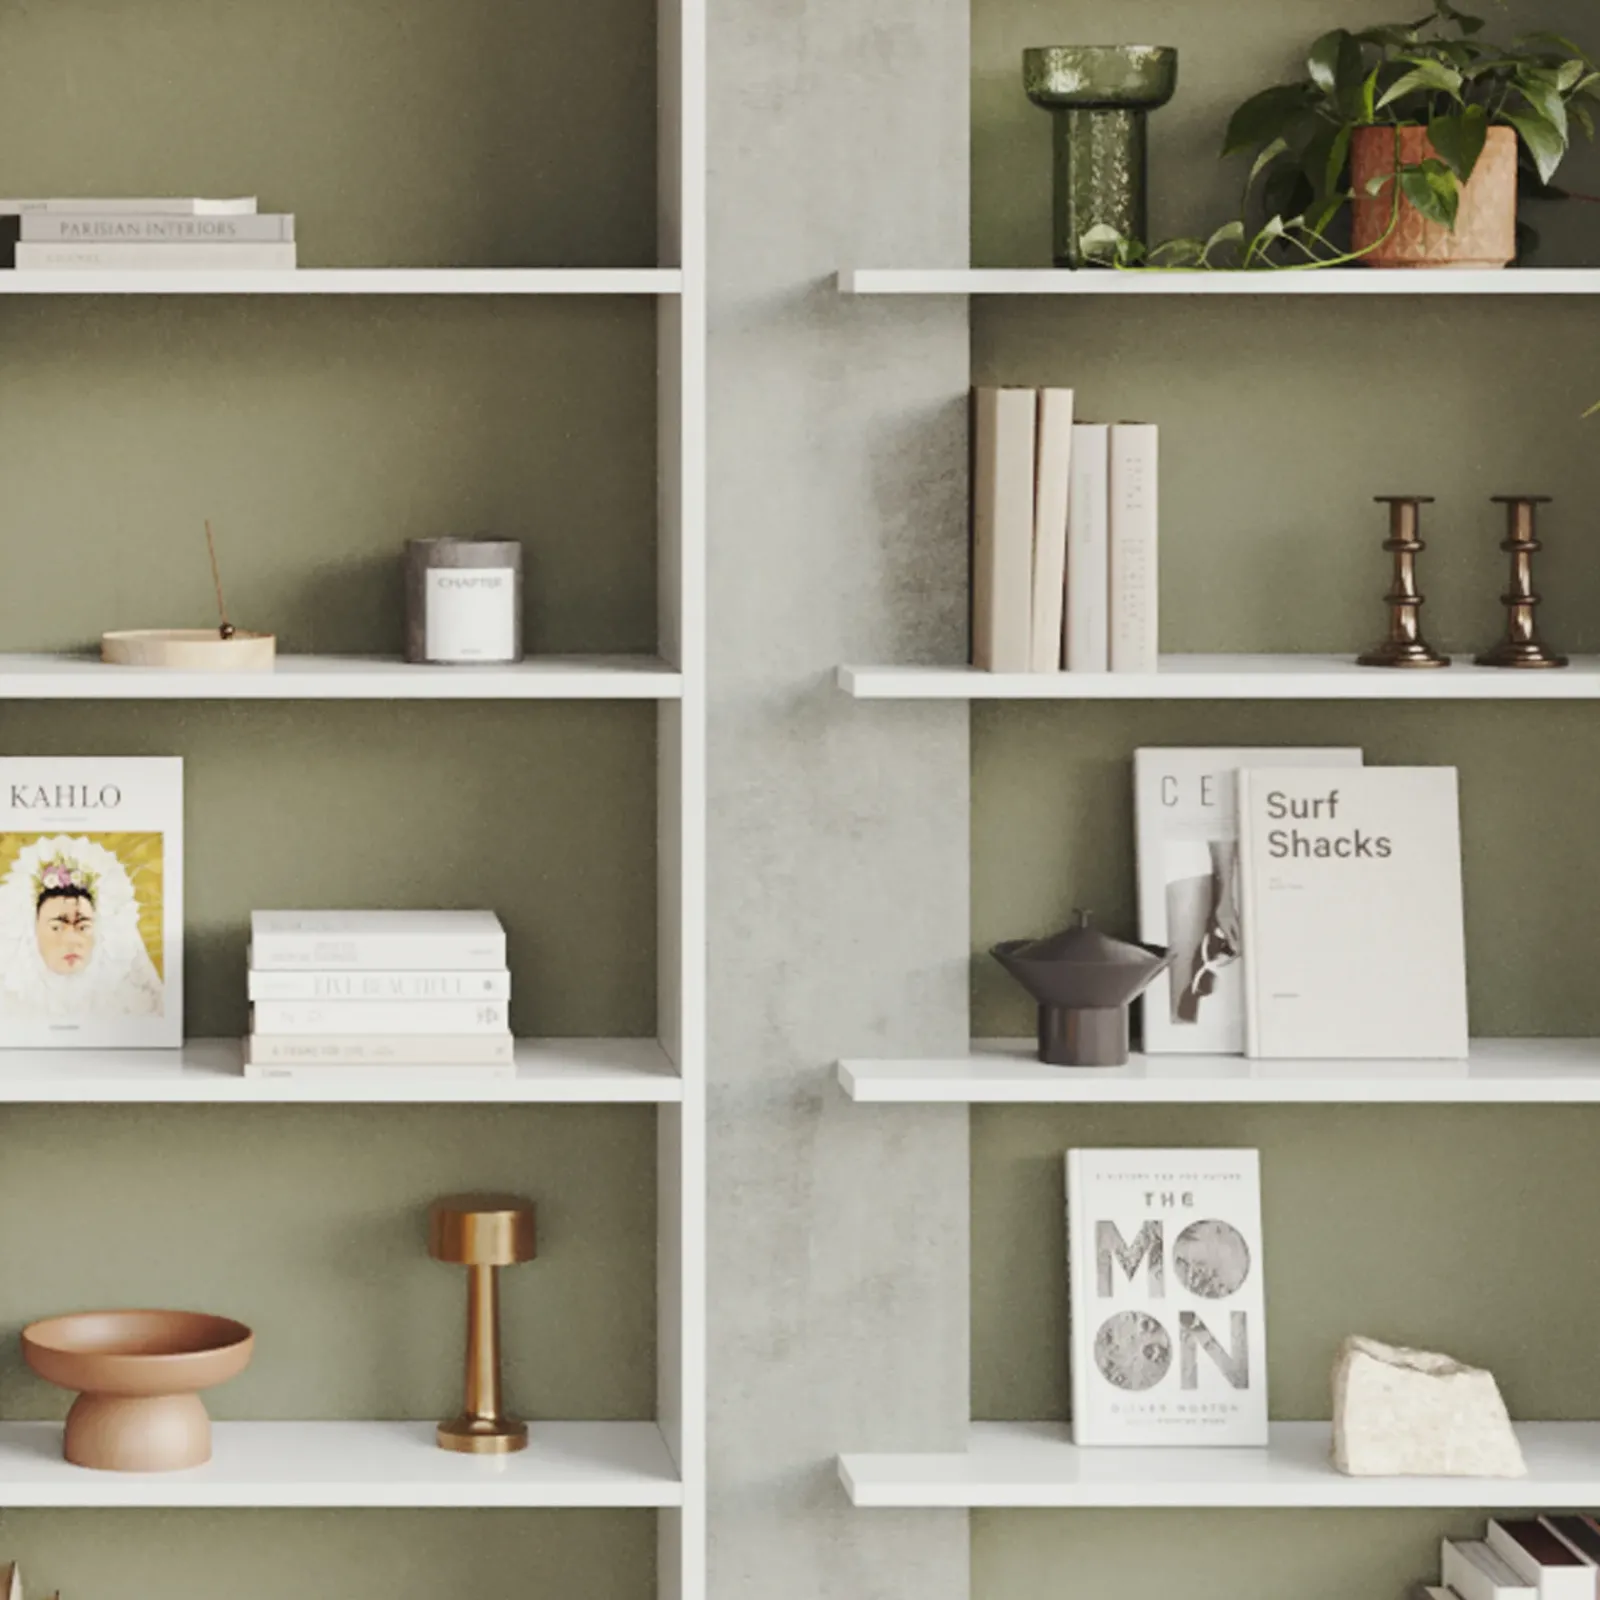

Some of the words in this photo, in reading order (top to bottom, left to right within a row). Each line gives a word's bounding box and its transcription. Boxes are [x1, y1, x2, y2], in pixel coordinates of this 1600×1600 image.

[60, 221, 140, 236] PARISIAN
[145, 221, 237, 236] INTERIORS
[10, 784, 121, 809] KAHLO
[1266, 789, 1339, 819] Surf
[1268, 829, 1392, 858] Shacks
[1144, 1191, 1194, 1208] THE
